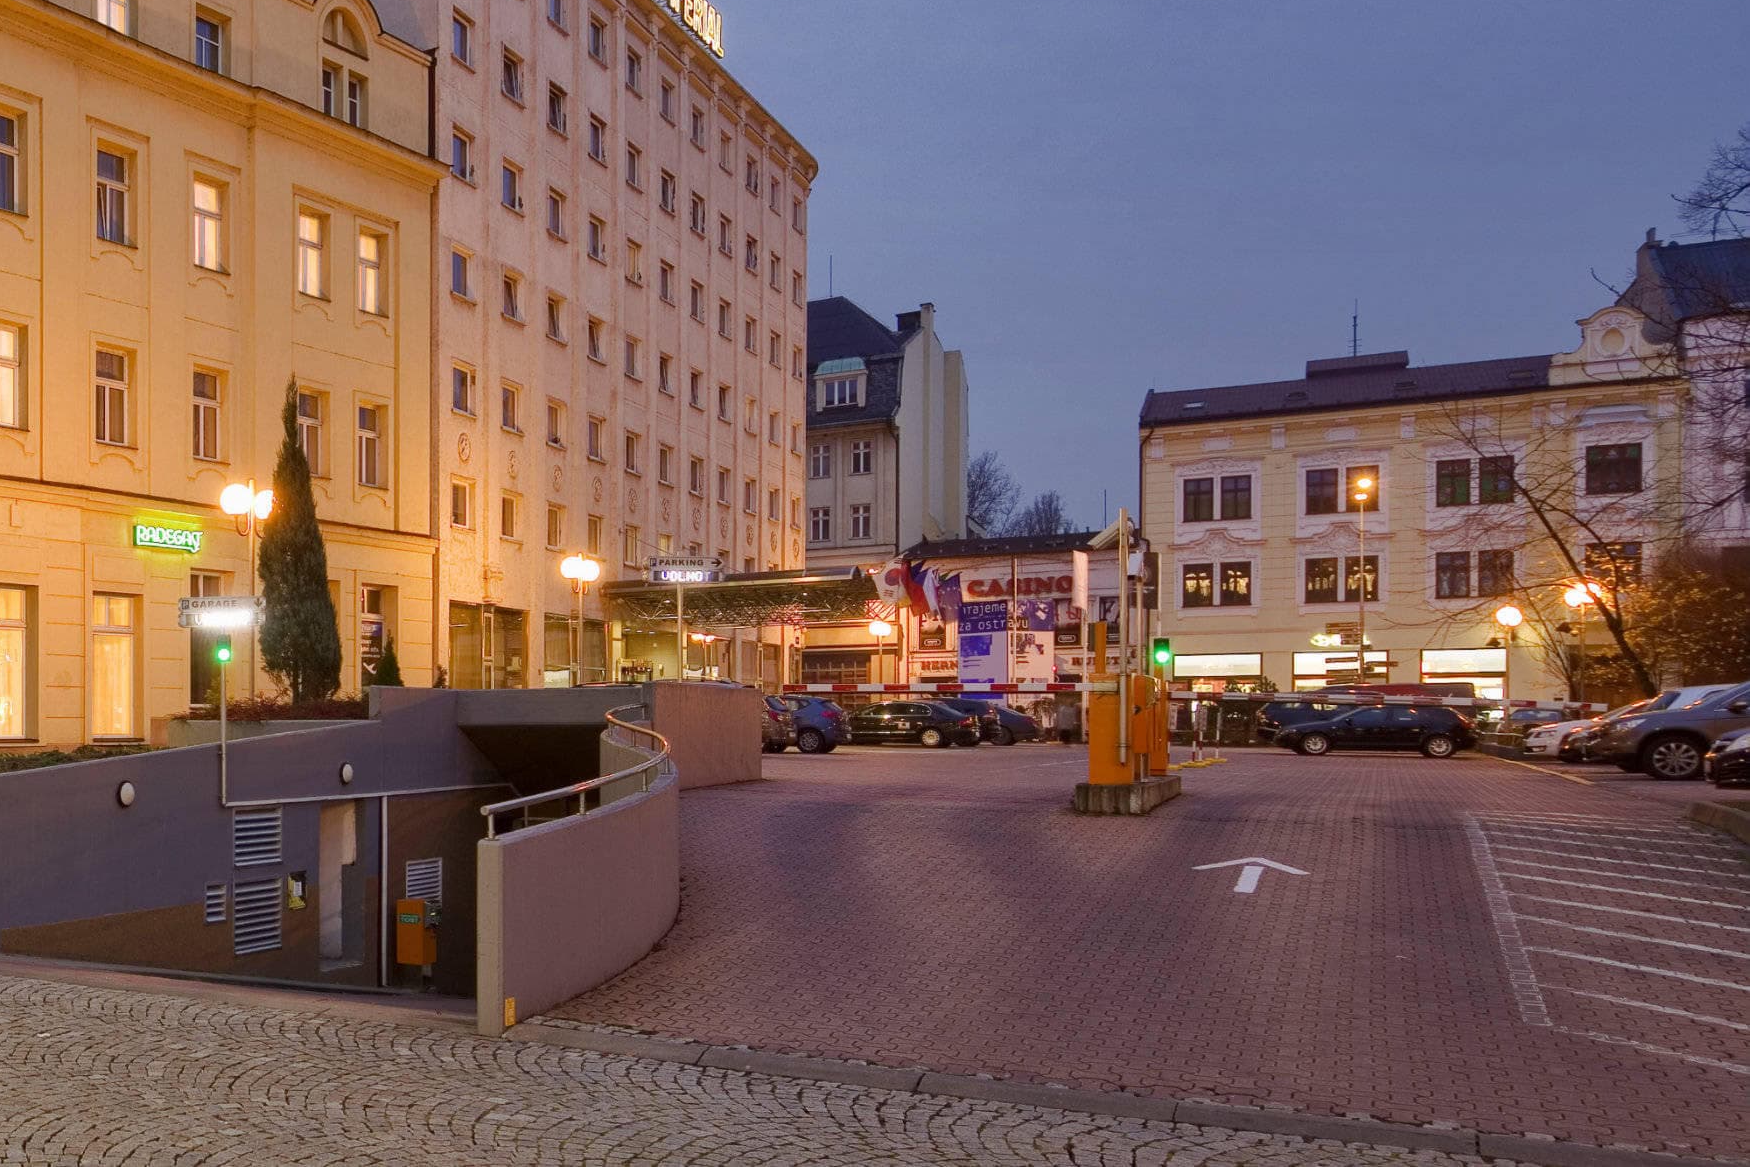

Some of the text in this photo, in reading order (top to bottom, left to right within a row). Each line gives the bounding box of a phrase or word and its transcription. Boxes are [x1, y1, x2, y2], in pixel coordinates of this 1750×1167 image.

[658, 559, 704, 567] PARKING
[967, 576, 1073, 597] CASINO
[191, 600, 238, 609] GARAGE
[959, 619, 1028, 632] za ostravu
[921, 661, 958, 671] HERN
